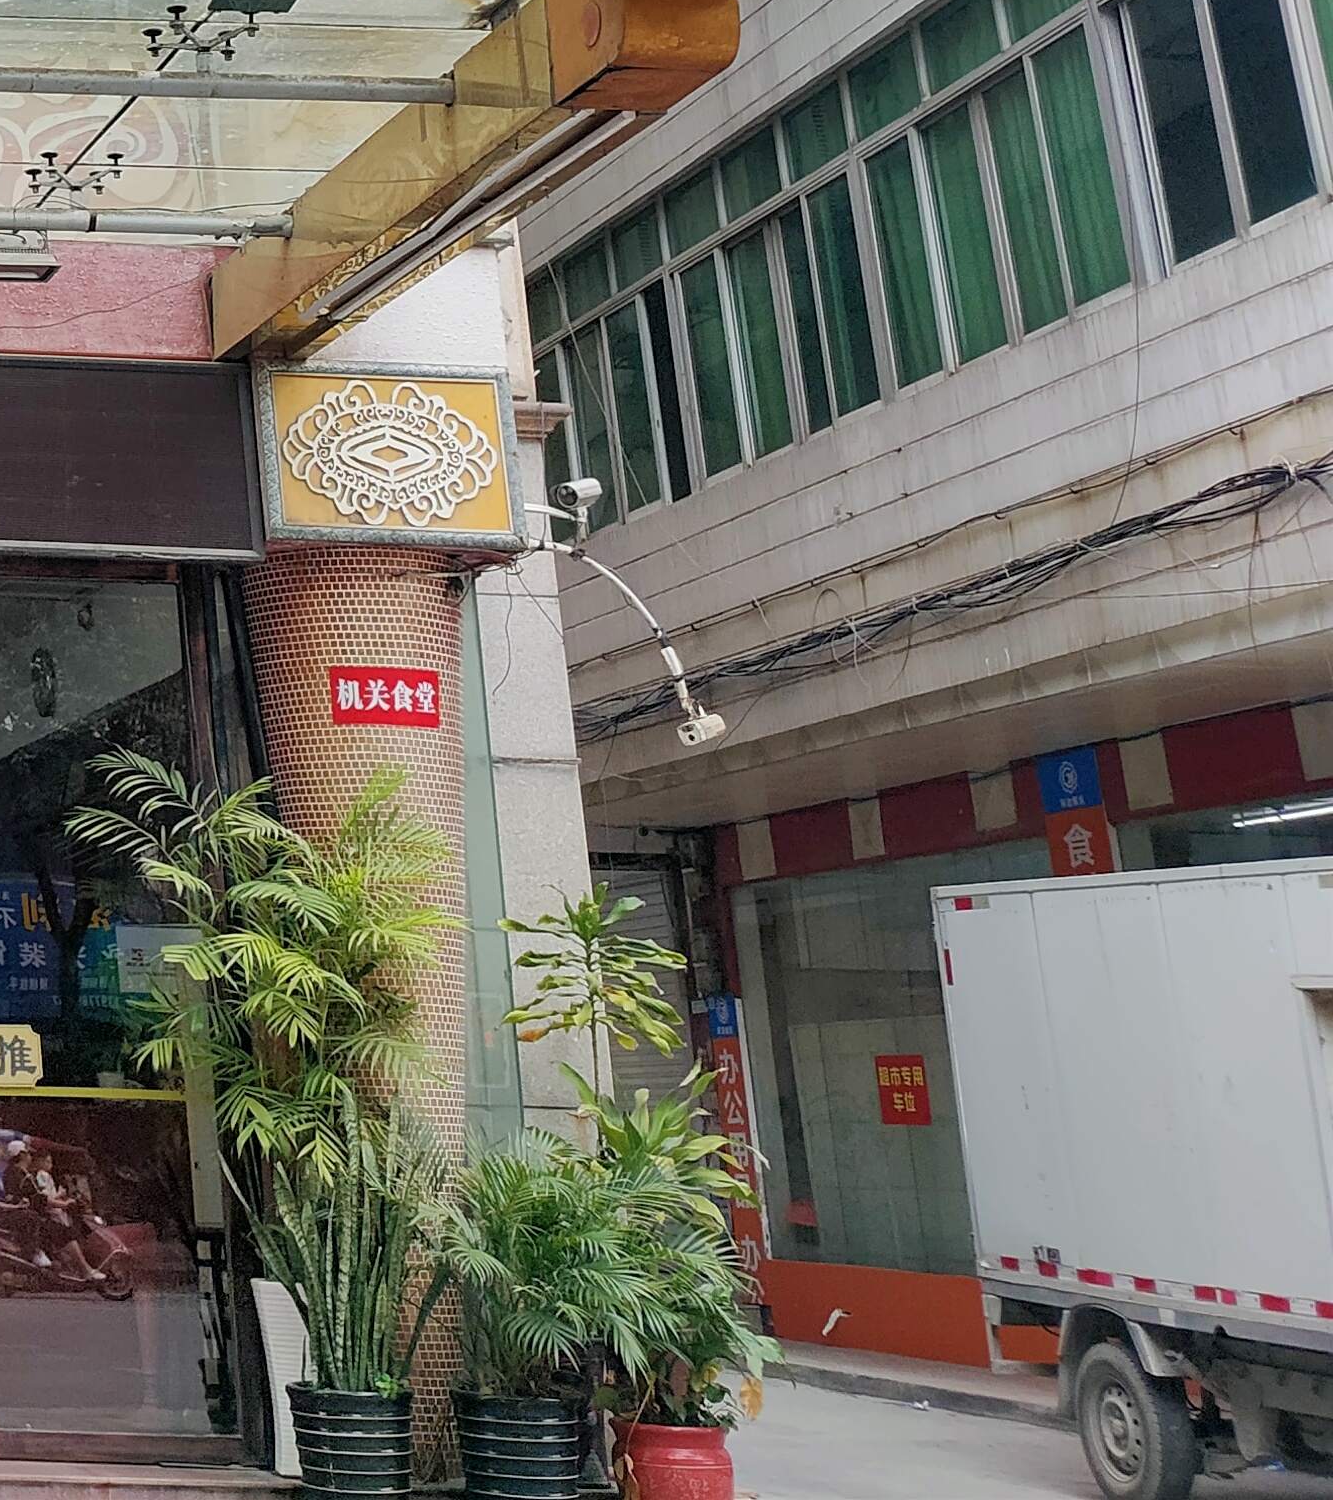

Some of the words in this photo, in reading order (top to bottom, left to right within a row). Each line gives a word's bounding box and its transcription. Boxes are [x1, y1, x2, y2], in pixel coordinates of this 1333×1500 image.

[336, 677, 437, 714] 机关食堂
[1062, 822, 1096, 869] 食
[877, 1066, 925, 1087] 超市专用
[893, 1091, 917, 1112] 车位
